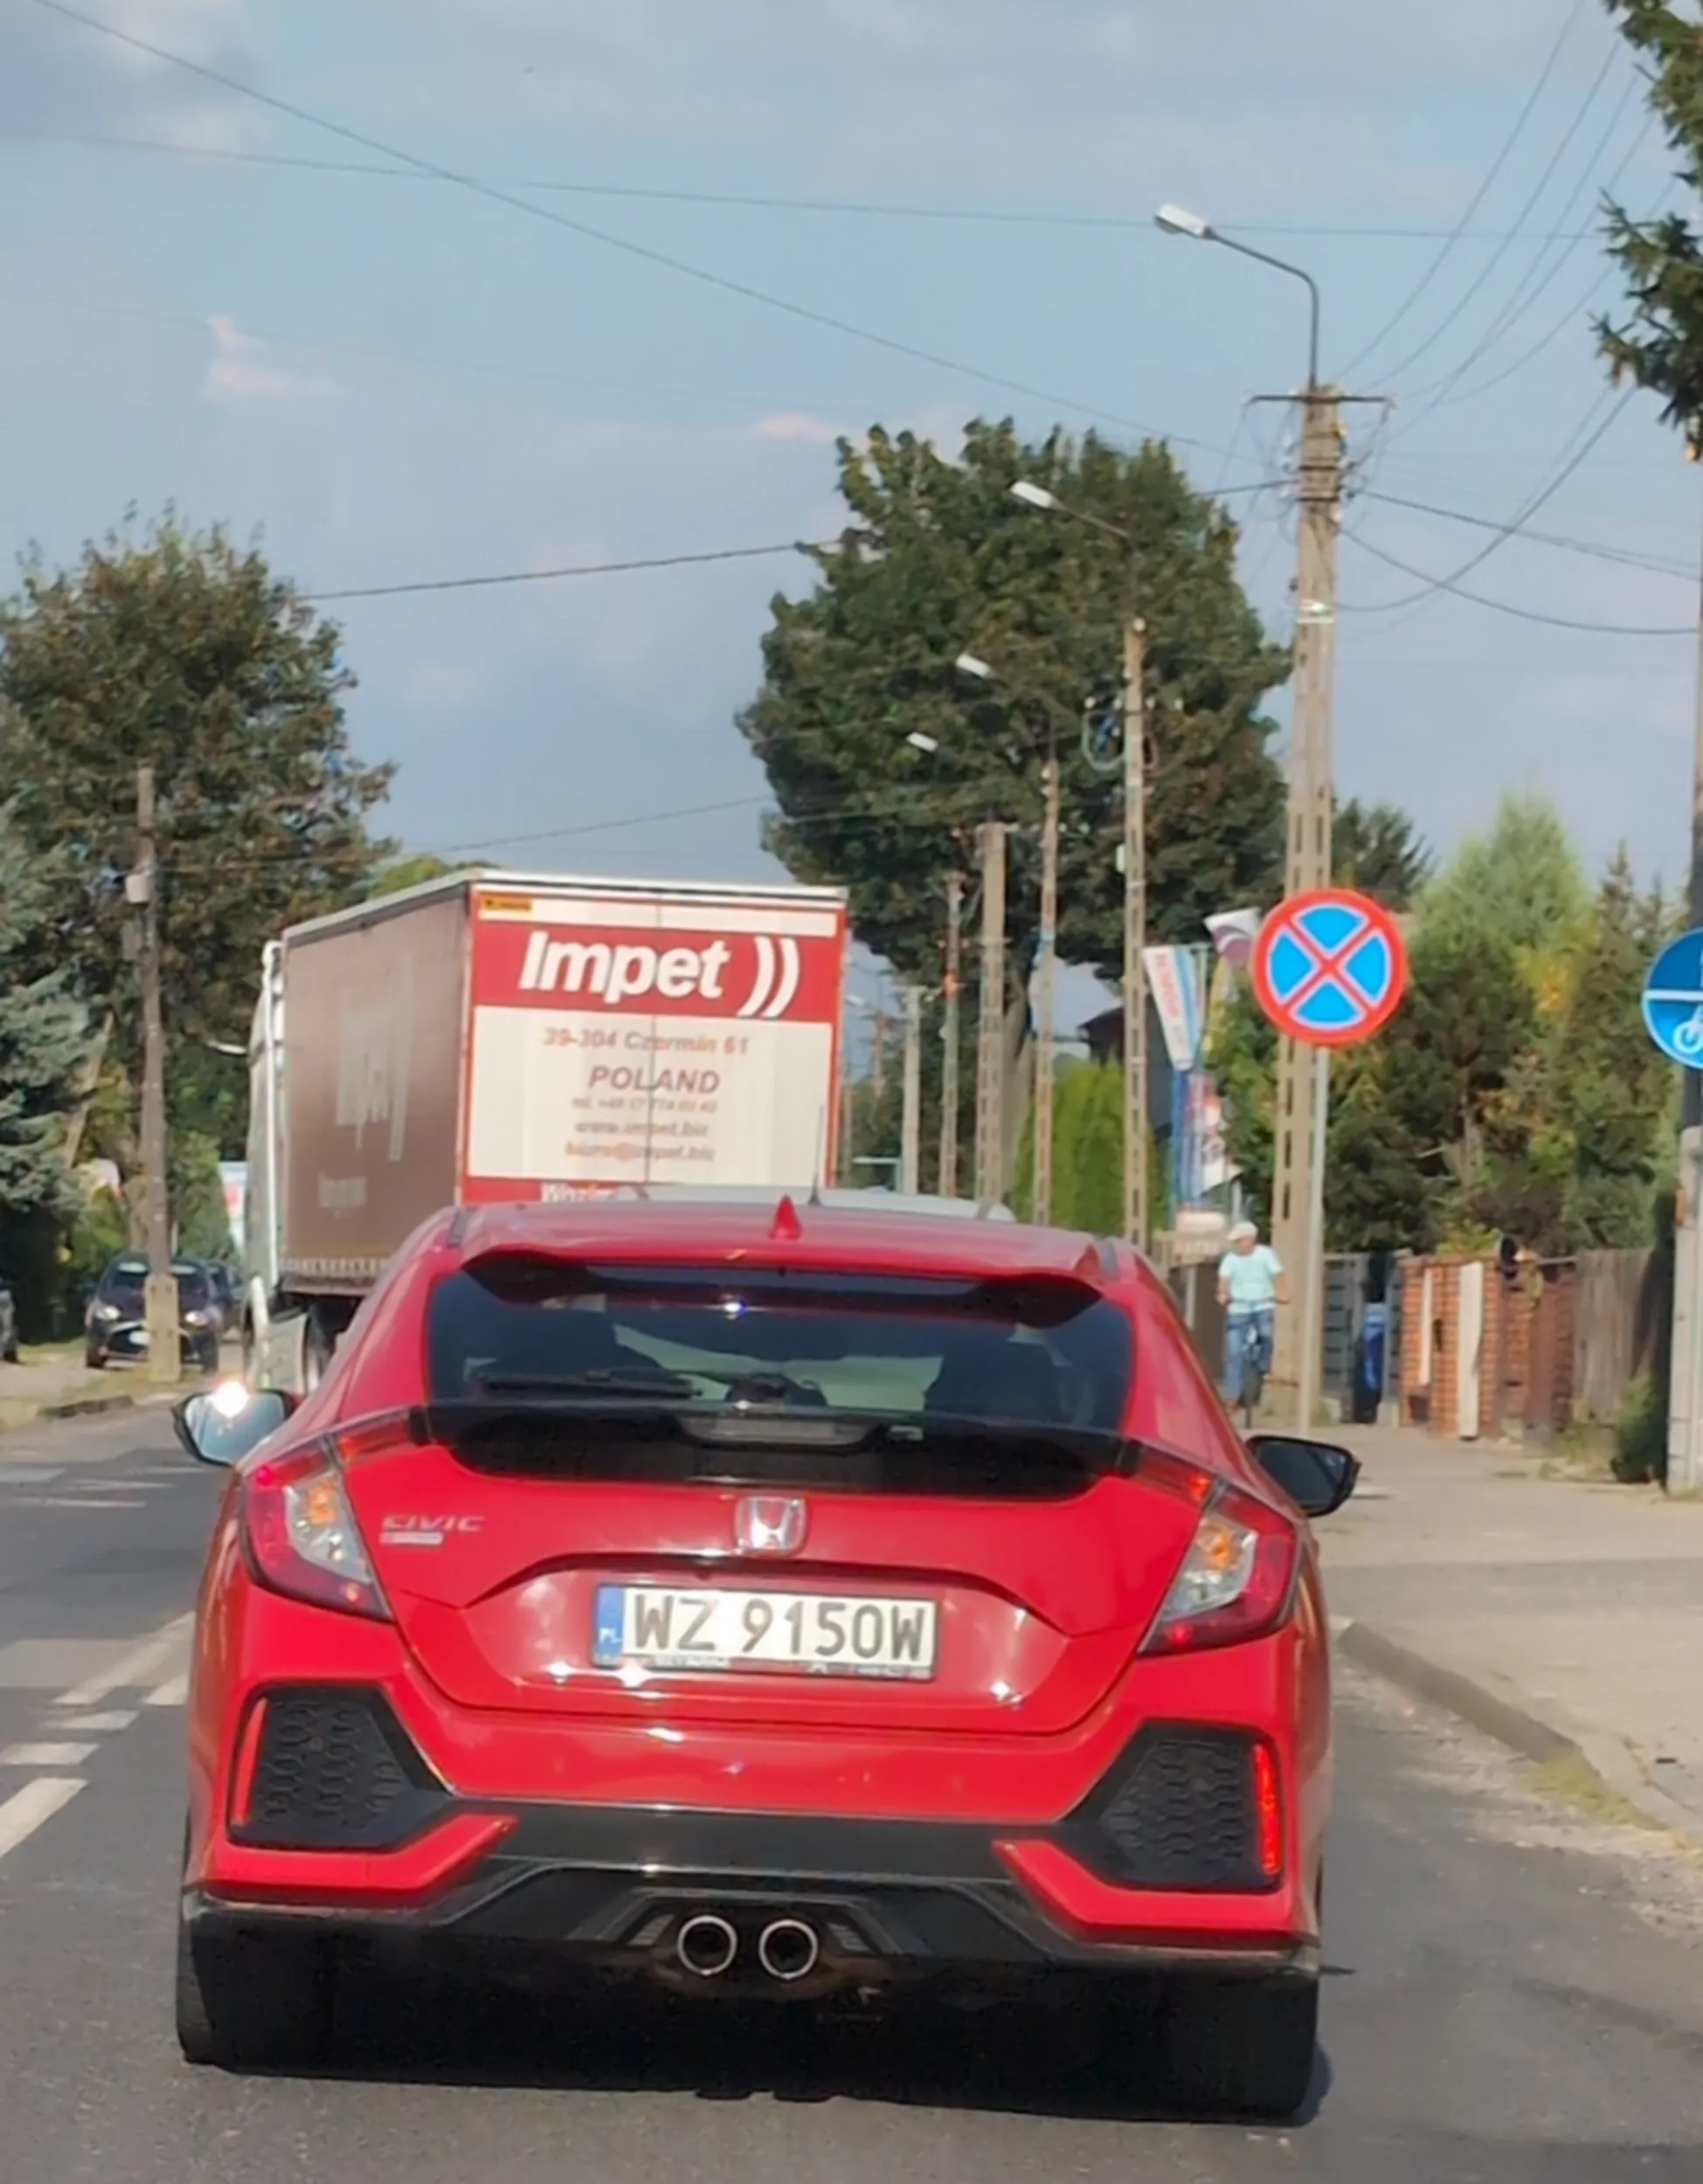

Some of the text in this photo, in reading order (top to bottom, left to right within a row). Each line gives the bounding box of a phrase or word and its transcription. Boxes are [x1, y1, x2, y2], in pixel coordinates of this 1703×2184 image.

[519, 931, 730, 1003] Impet
[543, 1027, 617, 1047] 39-304
[624, 1031, 717, 1053] Czermin
[589, 1065, 721, 1093] POLAND
[382, 1514, 486, 1532] CIVIC
[634, 1593, 926, 1662] WZ 9150W
